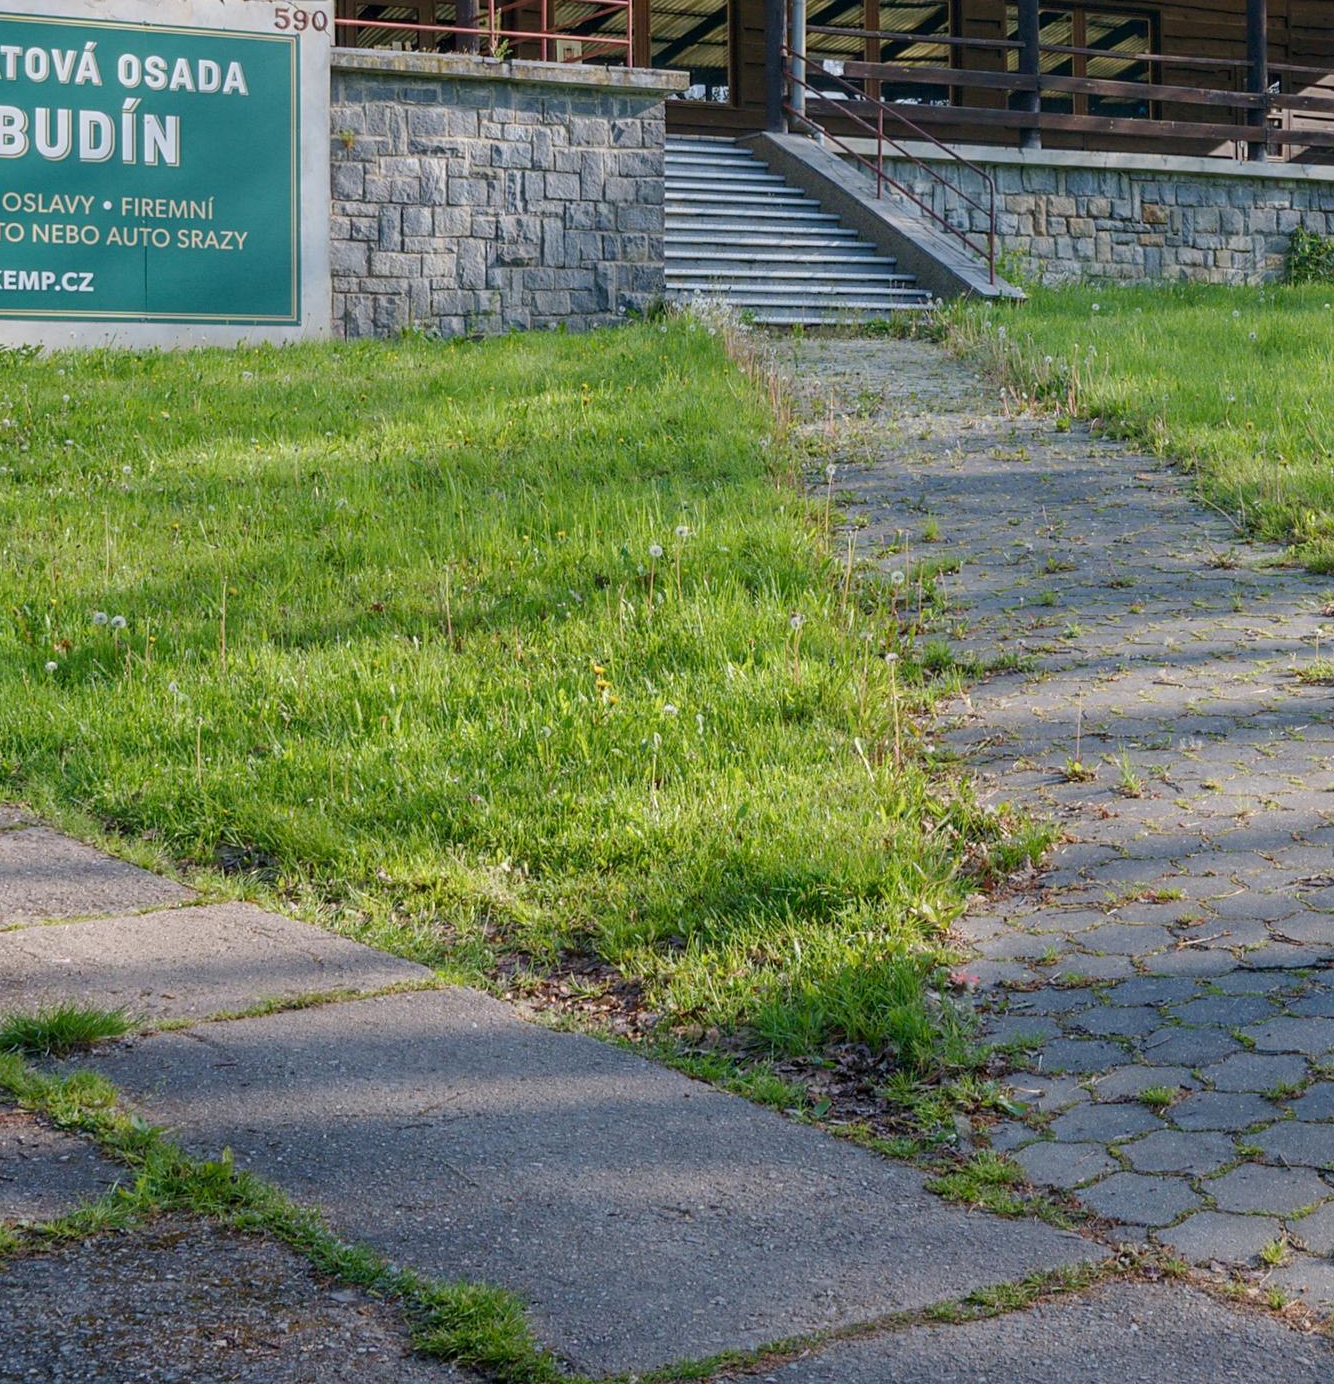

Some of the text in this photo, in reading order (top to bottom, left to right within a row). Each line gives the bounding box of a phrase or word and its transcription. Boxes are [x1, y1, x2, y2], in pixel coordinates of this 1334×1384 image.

[274, 8, 329, 31] 590
[118, 54, 249, 96] OSADA
[2, 192, 95, 215] OSLAVY
[122, 196, 214, 220] FIREMNÍ
[32, 224, 100, 246] NEBO
[106, 227, 171, 249] AUTO
[177, 230, 248, 250] SRAZY
